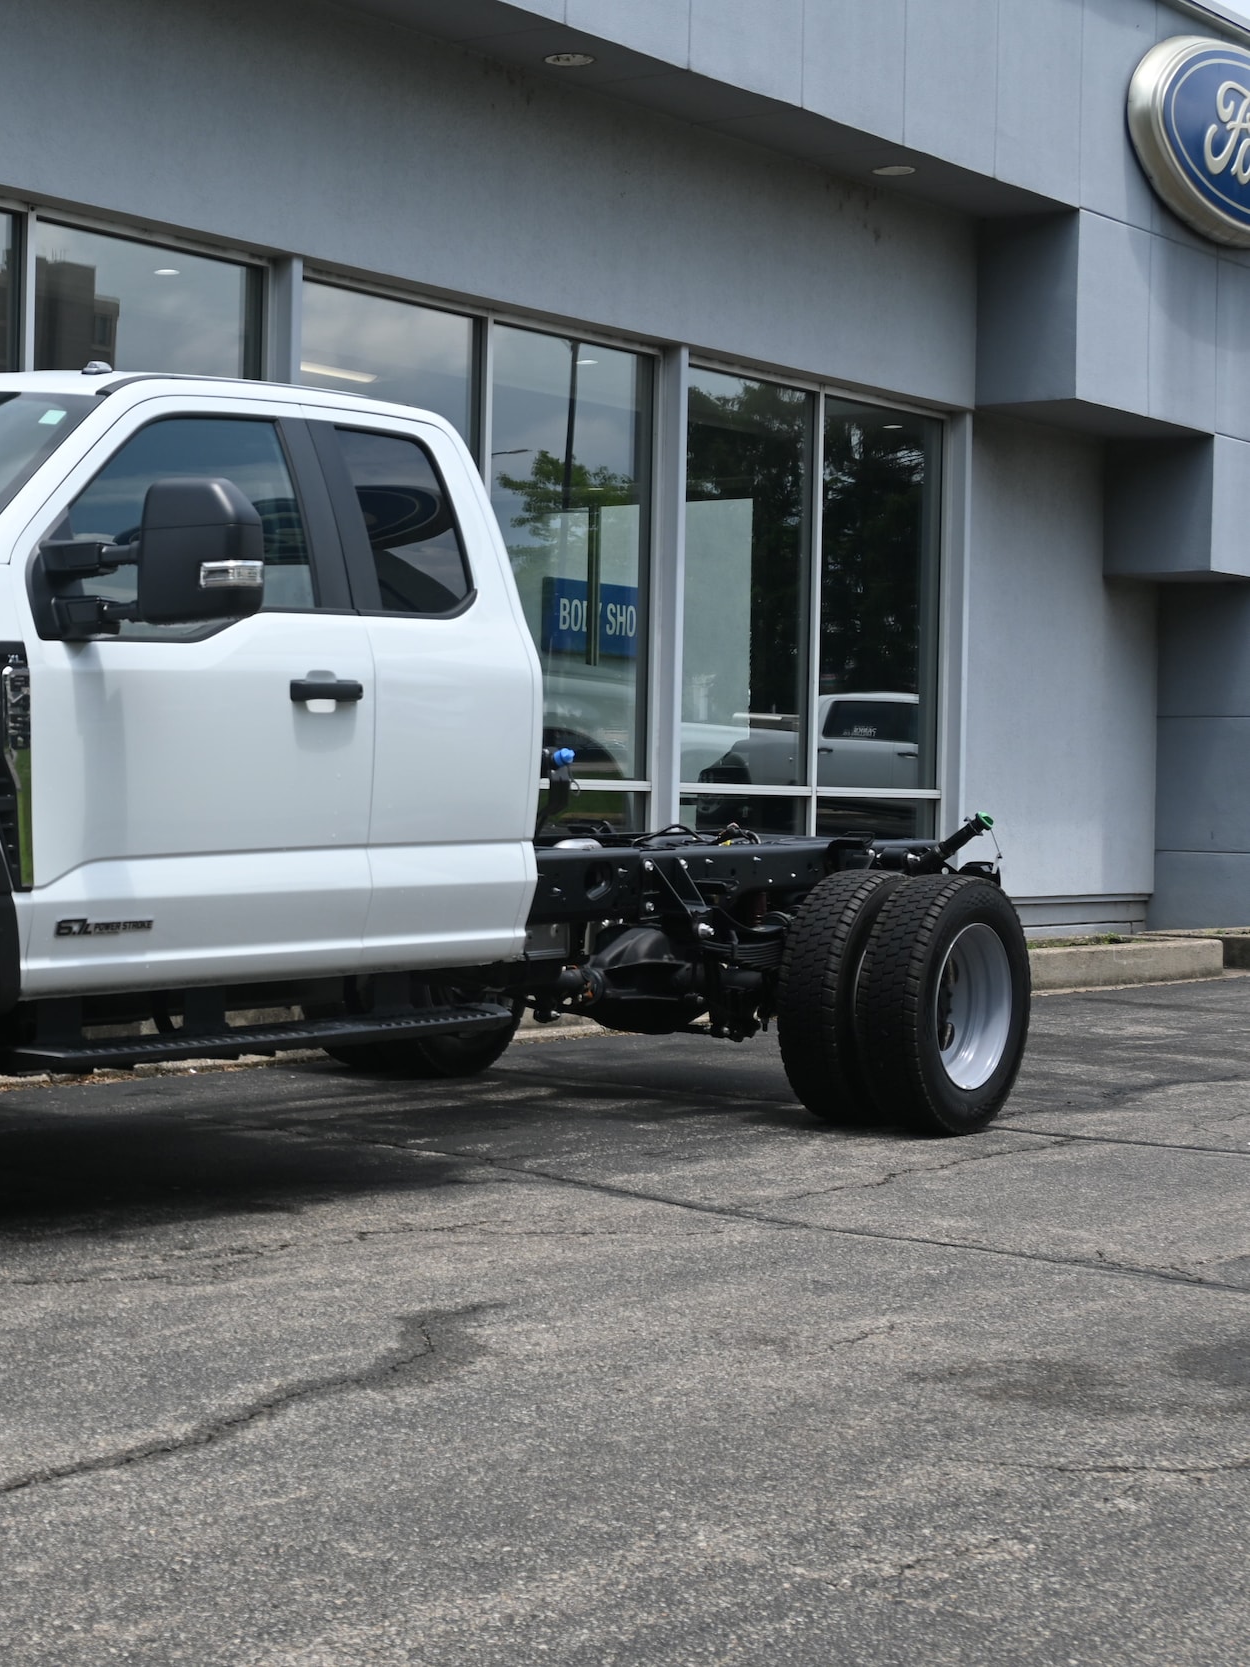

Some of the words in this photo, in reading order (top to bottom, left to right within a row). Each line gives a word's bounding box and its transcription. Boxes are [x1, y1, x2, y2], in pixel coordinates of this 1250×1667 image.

[559, 597, 602, 633] BO
[55, 918, 92, 936] 6.7L
[93, 922, 121, 931] POWER
[121, 920, 153, 930] STROKE
